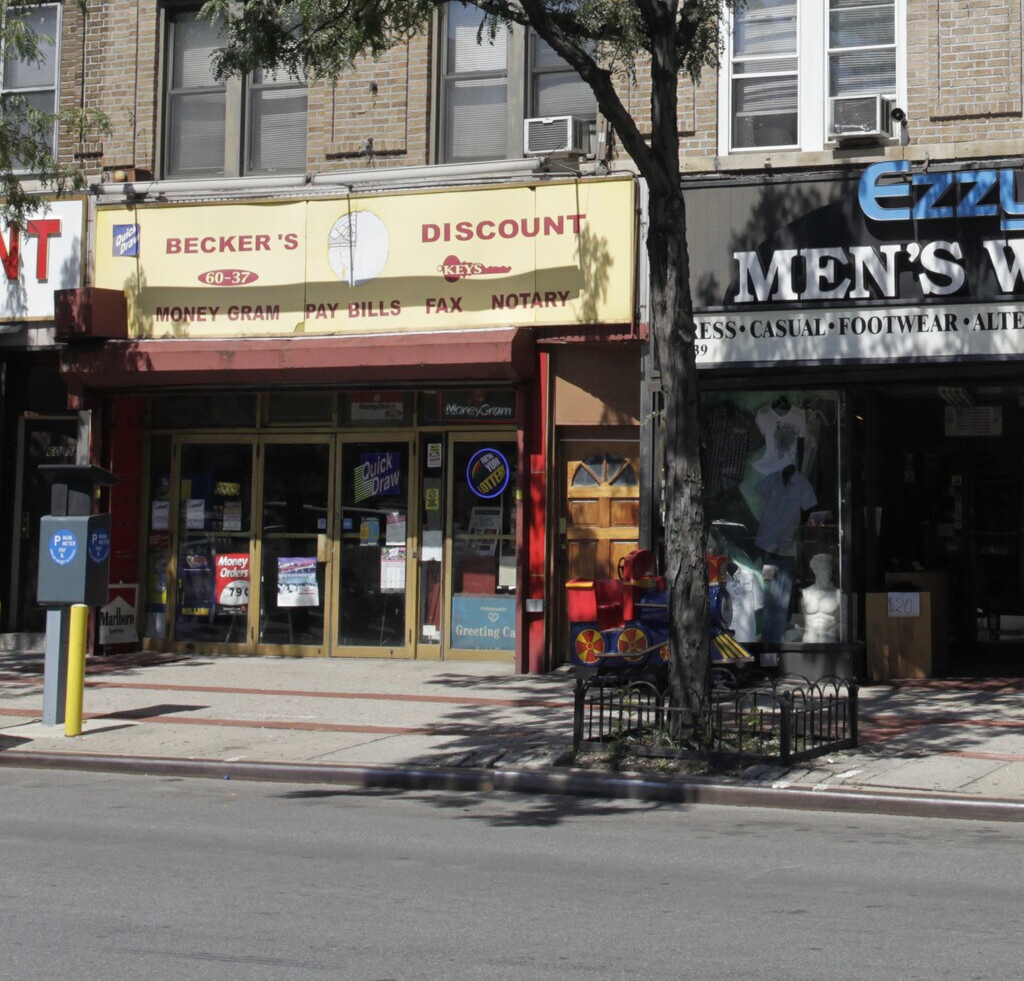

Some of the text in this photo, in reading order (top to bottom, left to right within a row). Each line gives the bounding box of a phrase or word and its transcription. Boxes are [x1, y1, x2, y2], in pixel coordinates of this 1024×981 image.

[421, 214, 586, 243] DISCOUNT
[205, 271, 250, 284] 60-37
[443, 262, 483, 276] KEYS
[733, 240, 967, 303] MEN'S
[156, 290, 570, 322] MONEY GRAM PAY BILLS FAX NOTARY
[694, 320, 737, 340] ESS
[750, 318, 826, 339] CASUAL
[839, 313, 959, 336] FOOTWEAR
[445, 403, 512, 417] MoneyGram
[361, 452, 393, 481] Quick
[372, 470, 400, 496] Draw
[54, 534, 62, 546] P
[218, 556, 248, 568] Money
[220, 567, 249, 578] Orders
[888, 597, 913, 614] $20
[101, 607, 134, 626] Marlboro
[455, 625, 500, 640] Greeting
